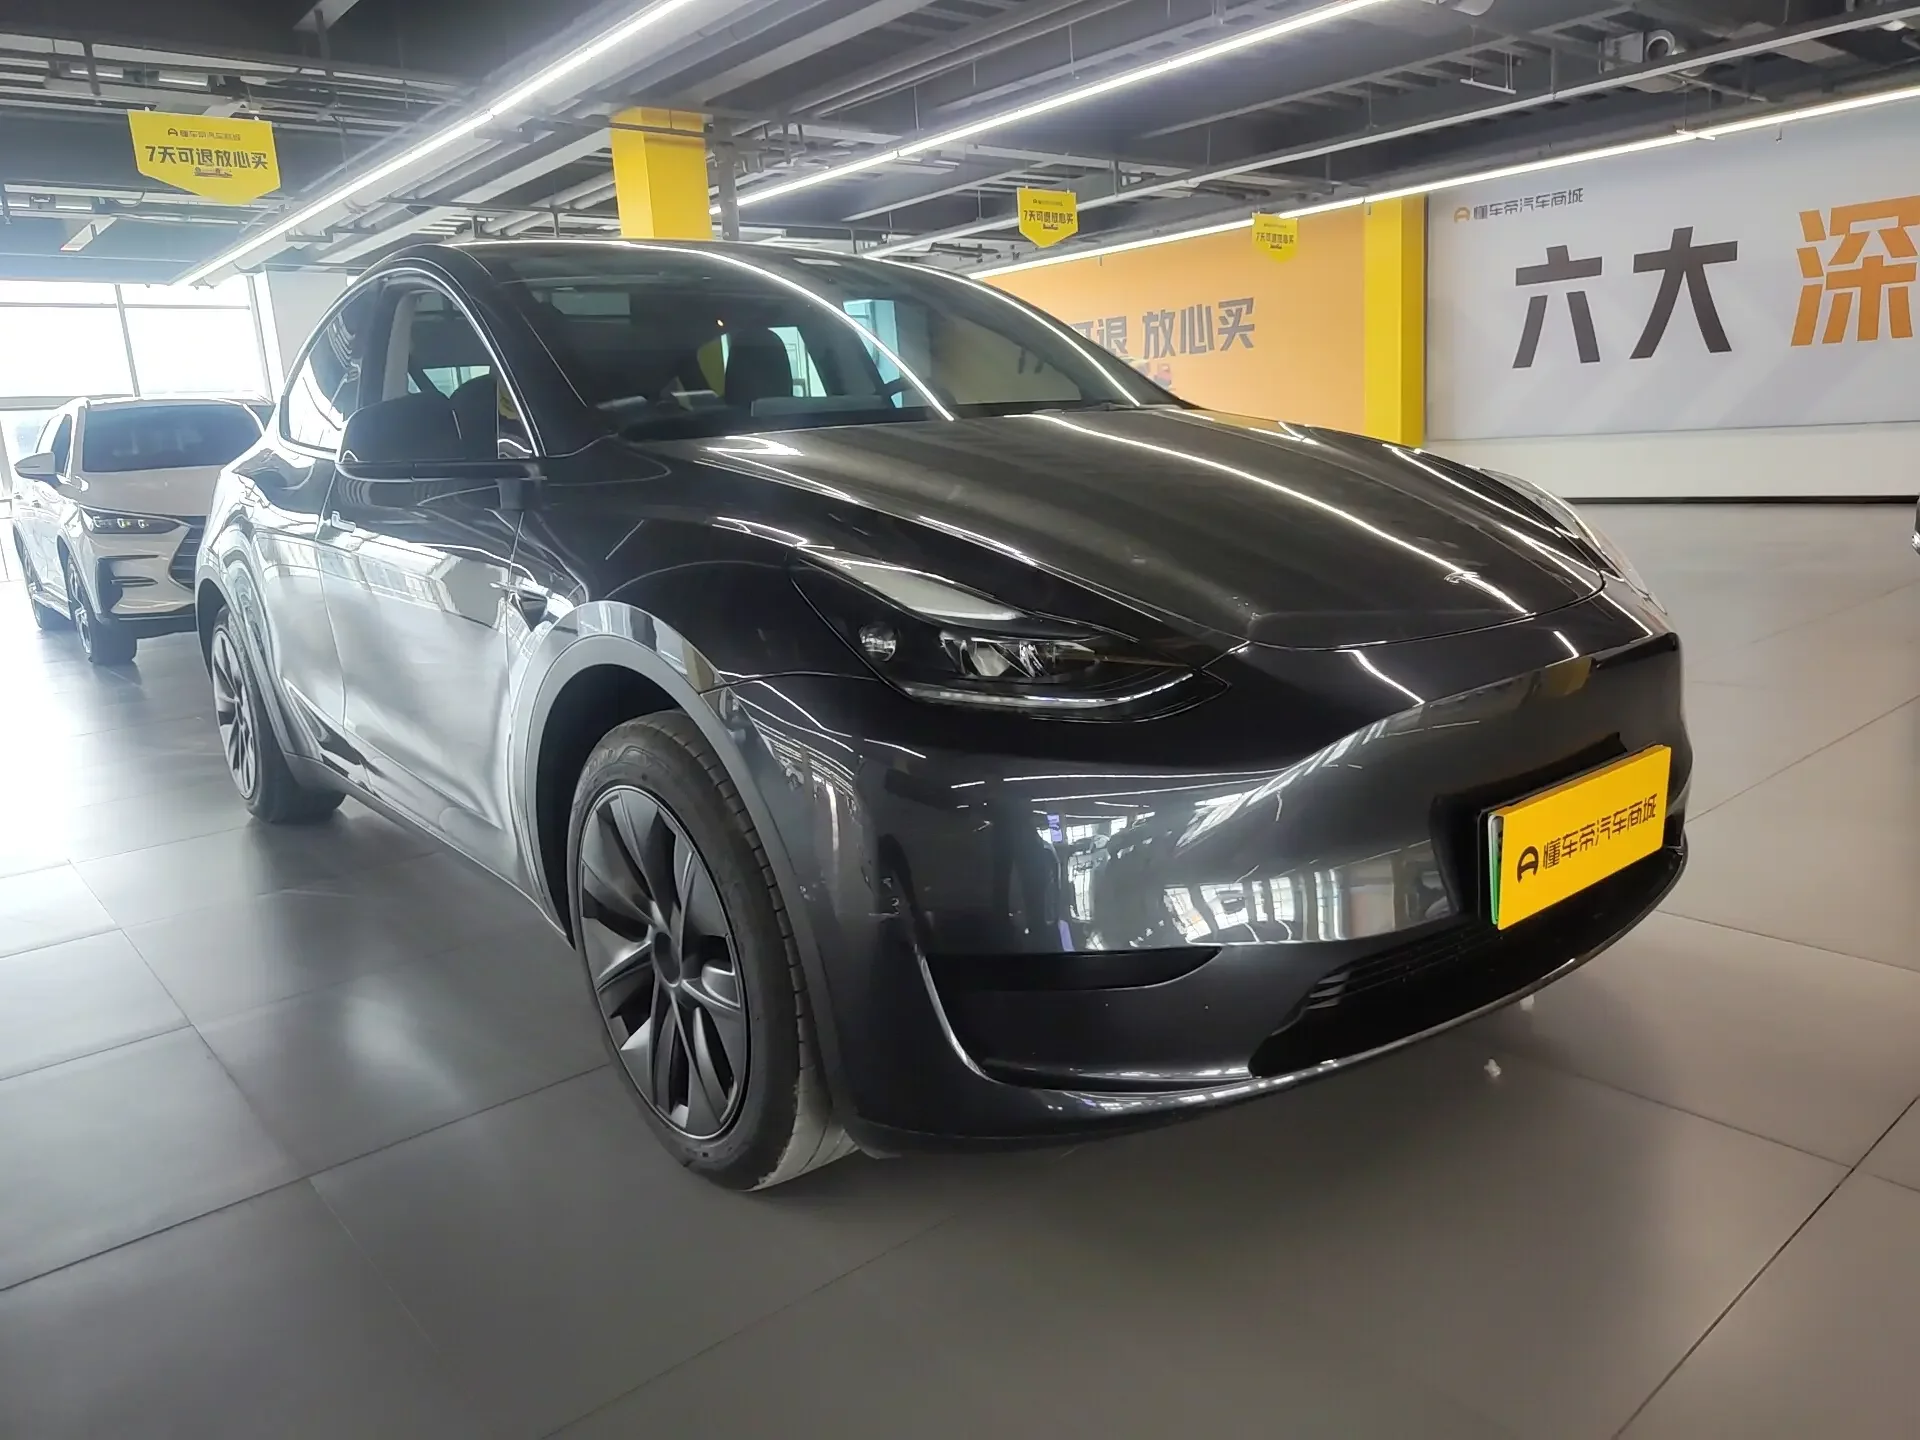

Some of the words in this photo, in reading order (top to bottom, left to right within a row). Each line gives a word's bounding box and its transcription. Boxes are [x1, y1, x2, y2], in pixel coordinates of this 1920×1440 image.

[145, 145, 268, 170] 7天可退放心买
[1473, 187, 1584, 220] 懂车帝汽车商城
[1512, 226, 1738, 368] 六大
[1790, 195, 1920, 347] 深
[1142, 297, 1255, 359] 放心买
[1543, 793, 1657, 869] 懂车帝汽车商城
